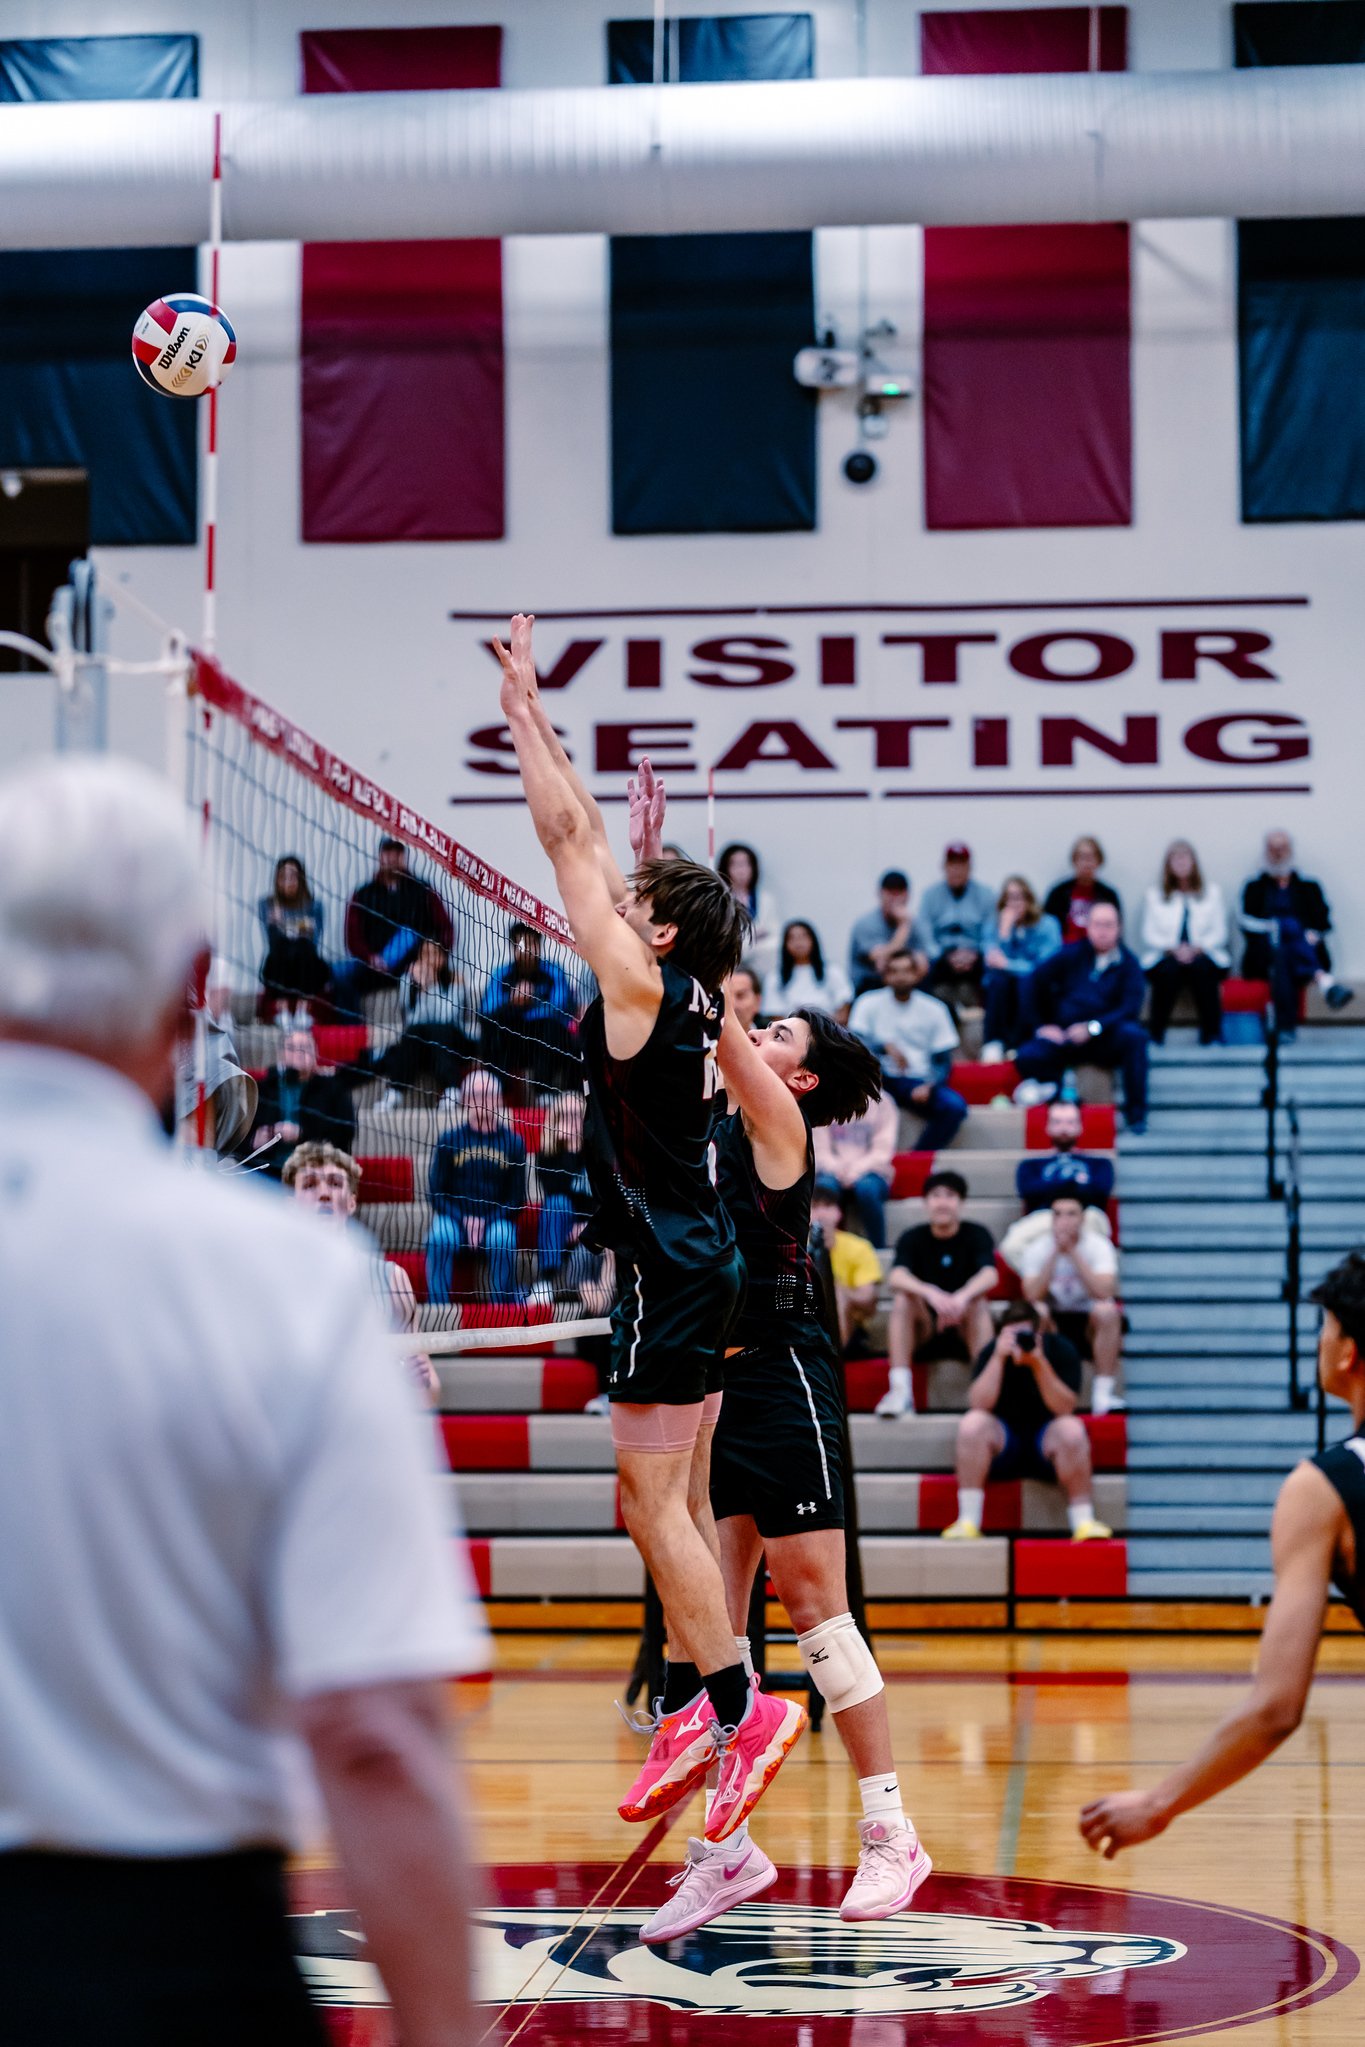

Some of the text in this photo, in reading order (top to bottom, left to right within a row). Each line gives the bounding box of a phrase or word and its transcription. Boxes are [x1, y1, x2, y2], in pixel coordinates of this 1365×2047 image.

[158, 326, 190, 369] Wilson
[481, 629, 1279, 689] VISITOR
[464, 713, 1311, 775] SEATING
